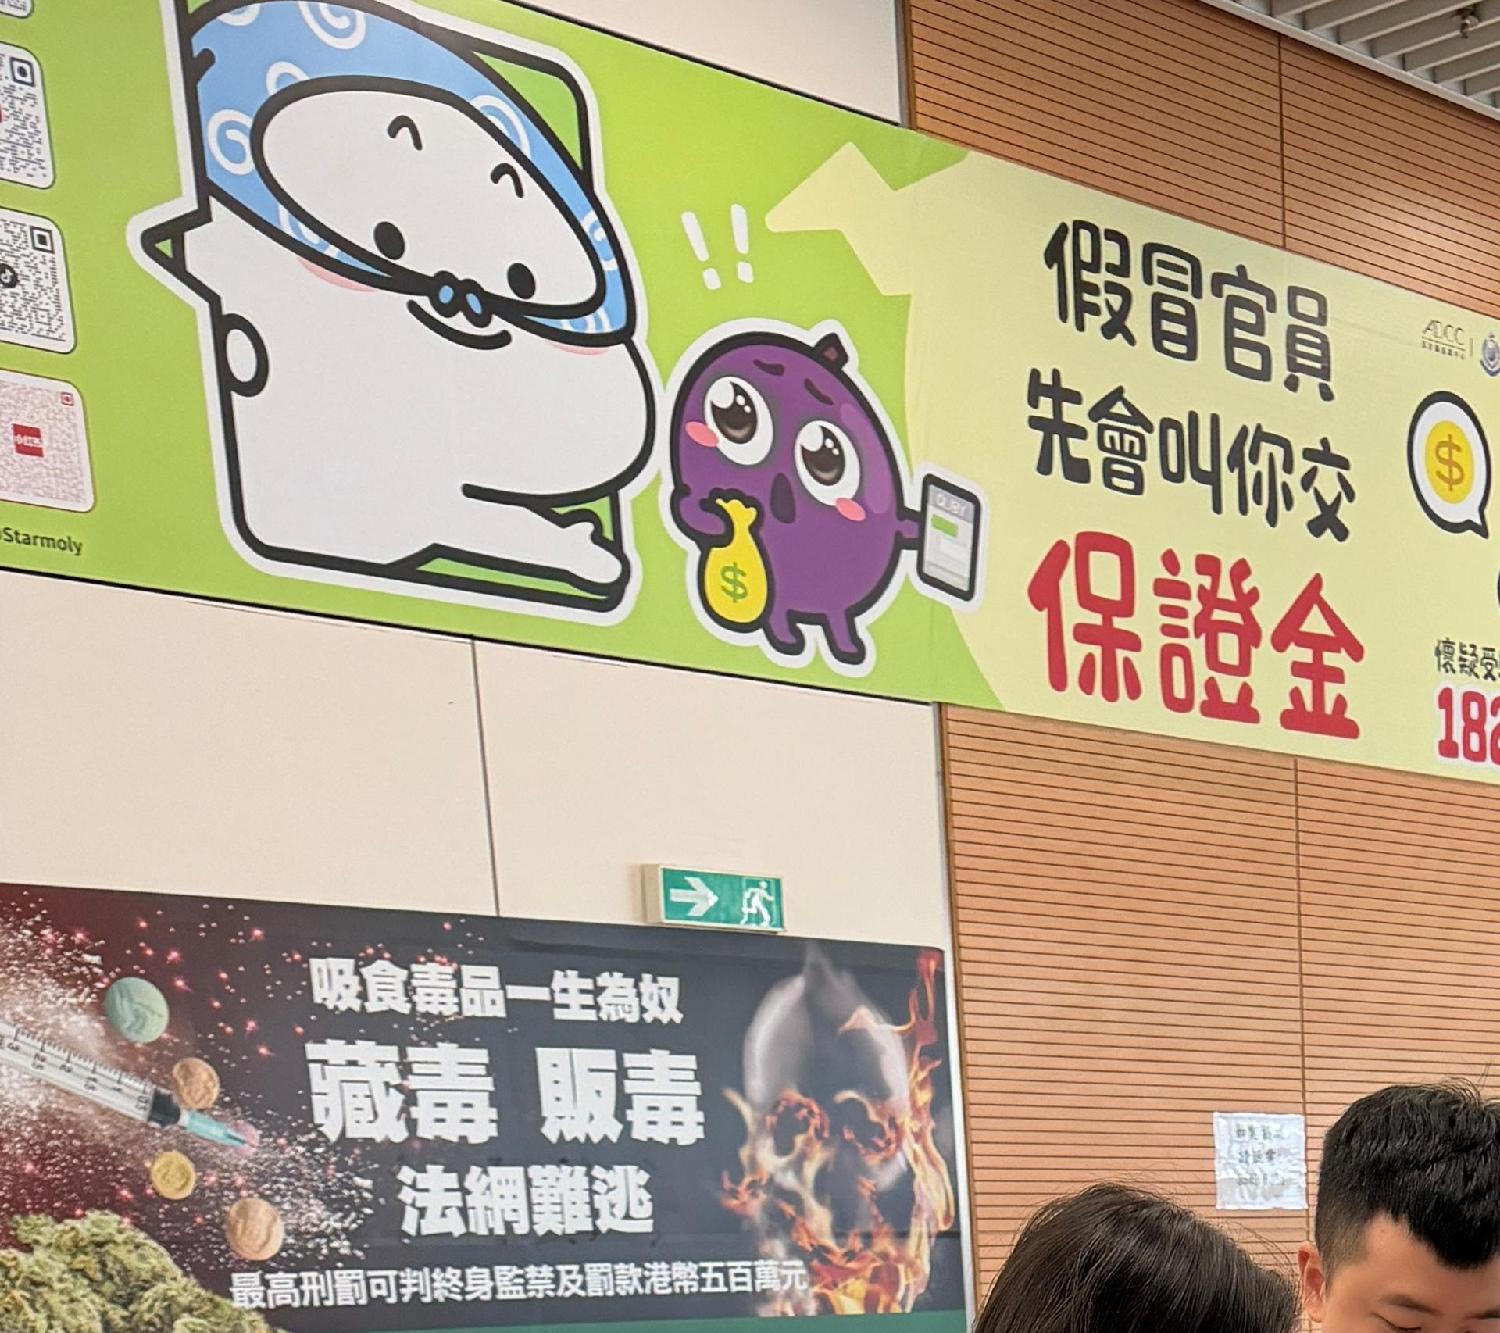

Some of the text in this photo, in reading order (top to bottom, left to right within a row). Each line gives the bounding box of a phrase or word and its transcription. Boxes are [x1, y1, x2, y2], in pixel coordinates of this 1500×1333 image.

[1043, 218, 1336, 402] 假冒官員
[1027, 367, 1356, 543] 先會叫你交
[1027, 530, 1365, 740] 保證金
[309, 958, 684, 1026] 吸食毒品一生為奴
[306, 1040, 705, 1147] 藏毒 販毒
[398, 1164, 654, 1239] 法網難逃
[229, 1259, 809, 1310] 最高刑罰可判終身監禁及罰款港幣五百萬元
